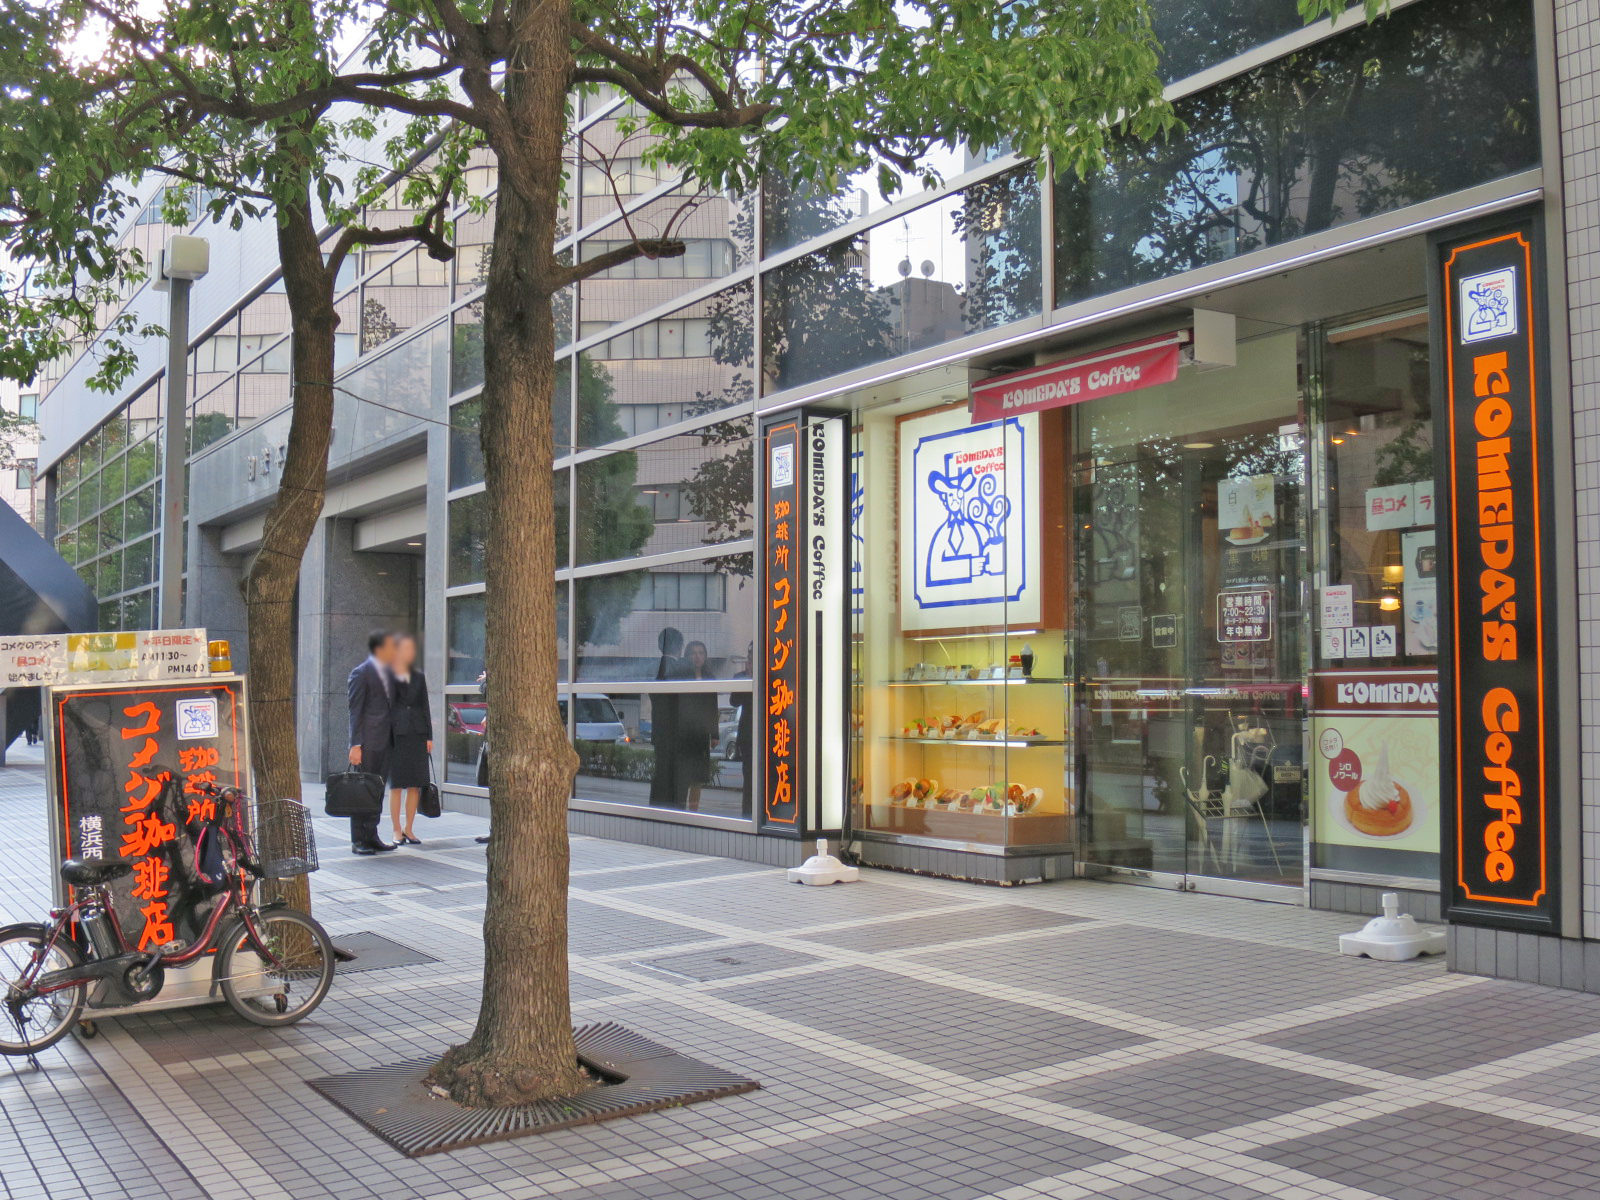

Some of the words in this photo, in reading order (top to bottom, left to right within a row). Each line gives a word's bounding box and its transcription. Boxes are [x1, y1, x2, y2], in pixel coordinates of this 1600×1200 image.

[1002, 377, 1081, 410] KOMEDA'S
[1087, 364, 1141, 391] Coffee
[955, 446, 1004, 465] KOMEDA'S
[973, 462, 1006, 476] Coffee
[813, 423, 825, 527] KOMEDA'S
[1372, 494, 1408, 516] 昼コメ
[1473, 350, 1518, 661] KOMEDA'S
[773, 500, 791, 571] 珈琲所
[812, 535, 826, 600] Coffee
[1225, 595, 1262, 608] 営業時間
[1226, 625, 1263, 637] 年中無休
[167, 663, 205, 674] PM14:00
[769, 577, 794, 806] コメダ珈琲店
[1333, 771, 1359, 780] ノワール
[1338, 763, 1352, 771] シロ
[1482, 686, 1522, 883] Coffee
[119, 700, 176, 951] コメダ珈琲店
